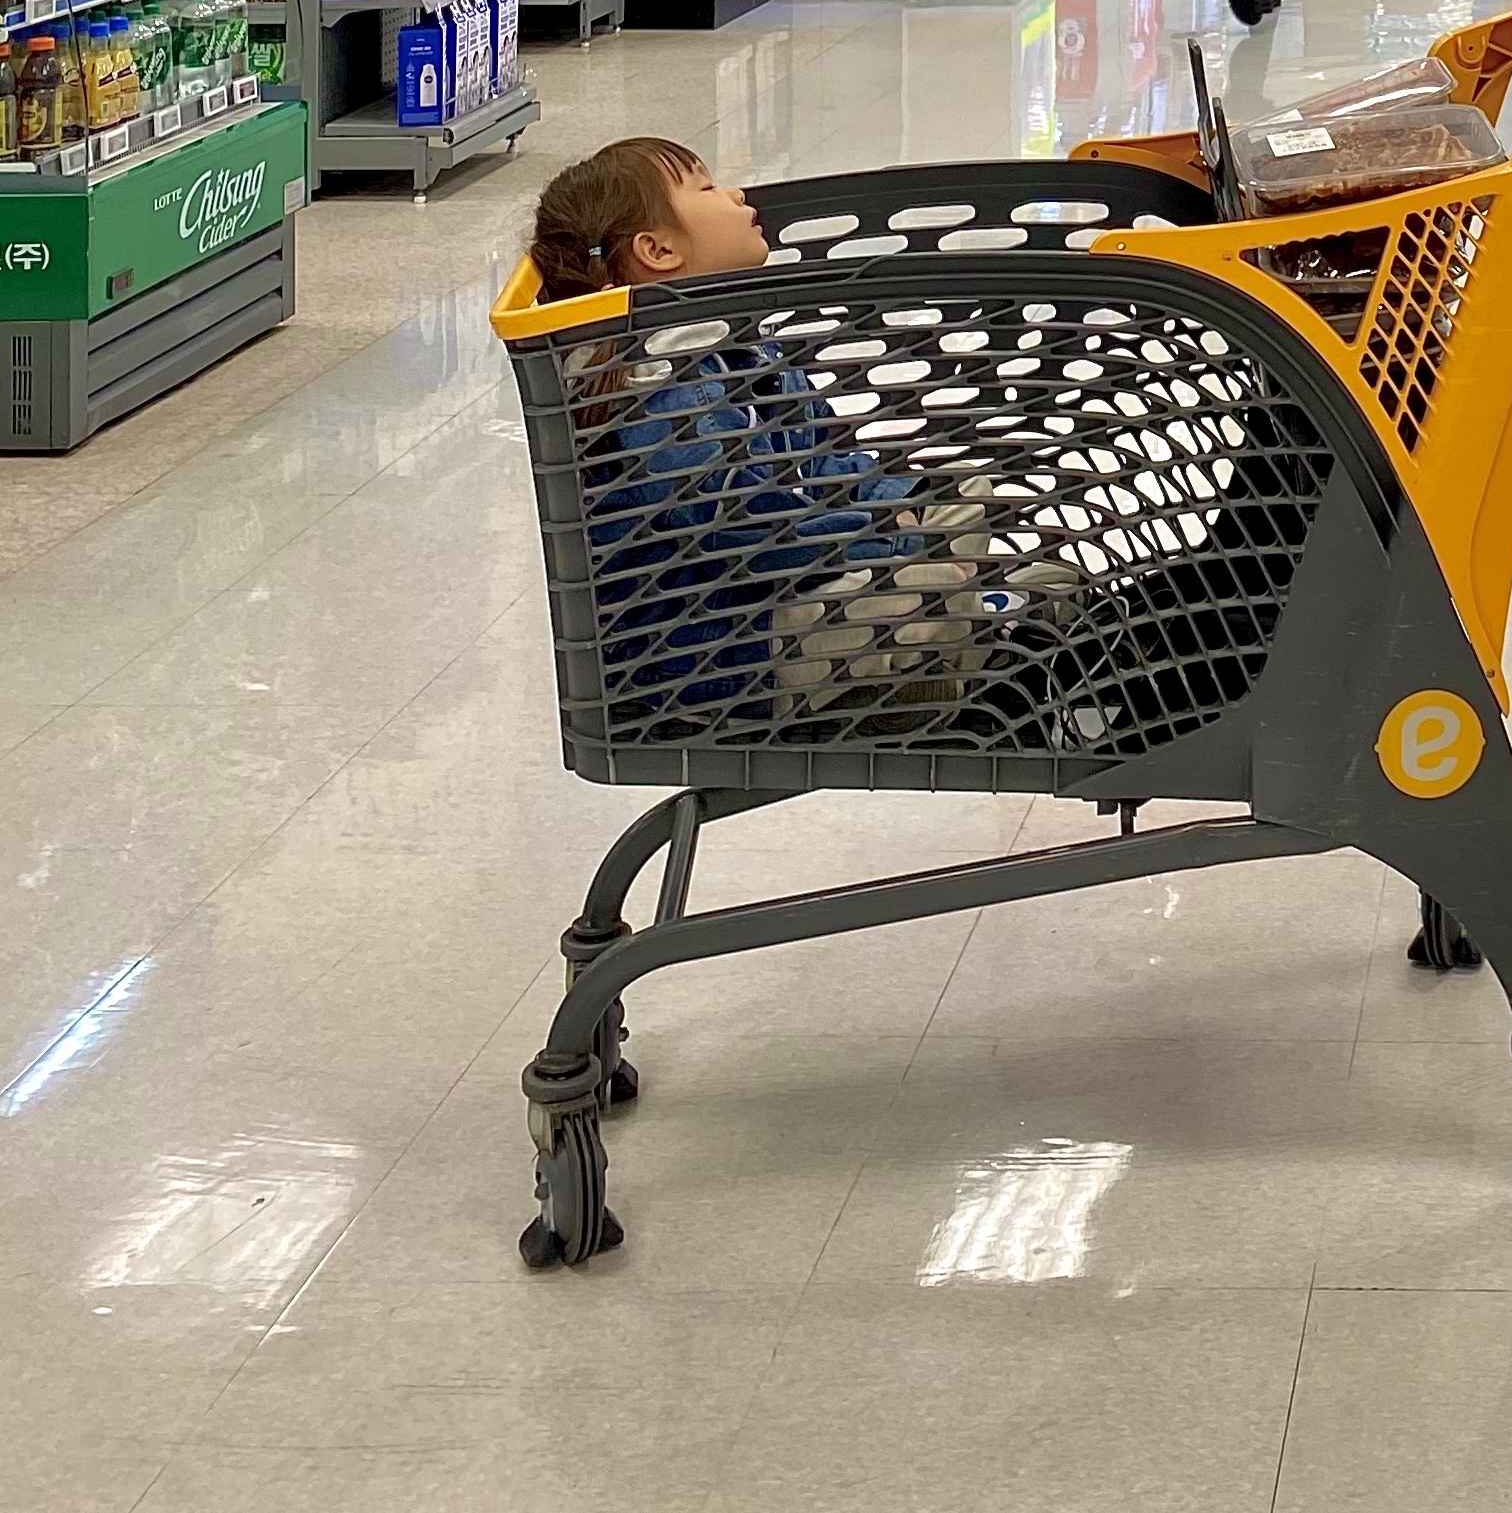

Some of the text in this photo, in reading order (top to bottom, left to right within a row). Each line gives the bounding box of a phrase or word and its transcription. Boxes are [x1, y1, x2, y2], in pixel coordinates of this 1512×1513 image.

[154, 187, 183, 211] LOTTE
[179, 160, 266, 239] Chilsung
[4, 242, 50, 271] (주)
